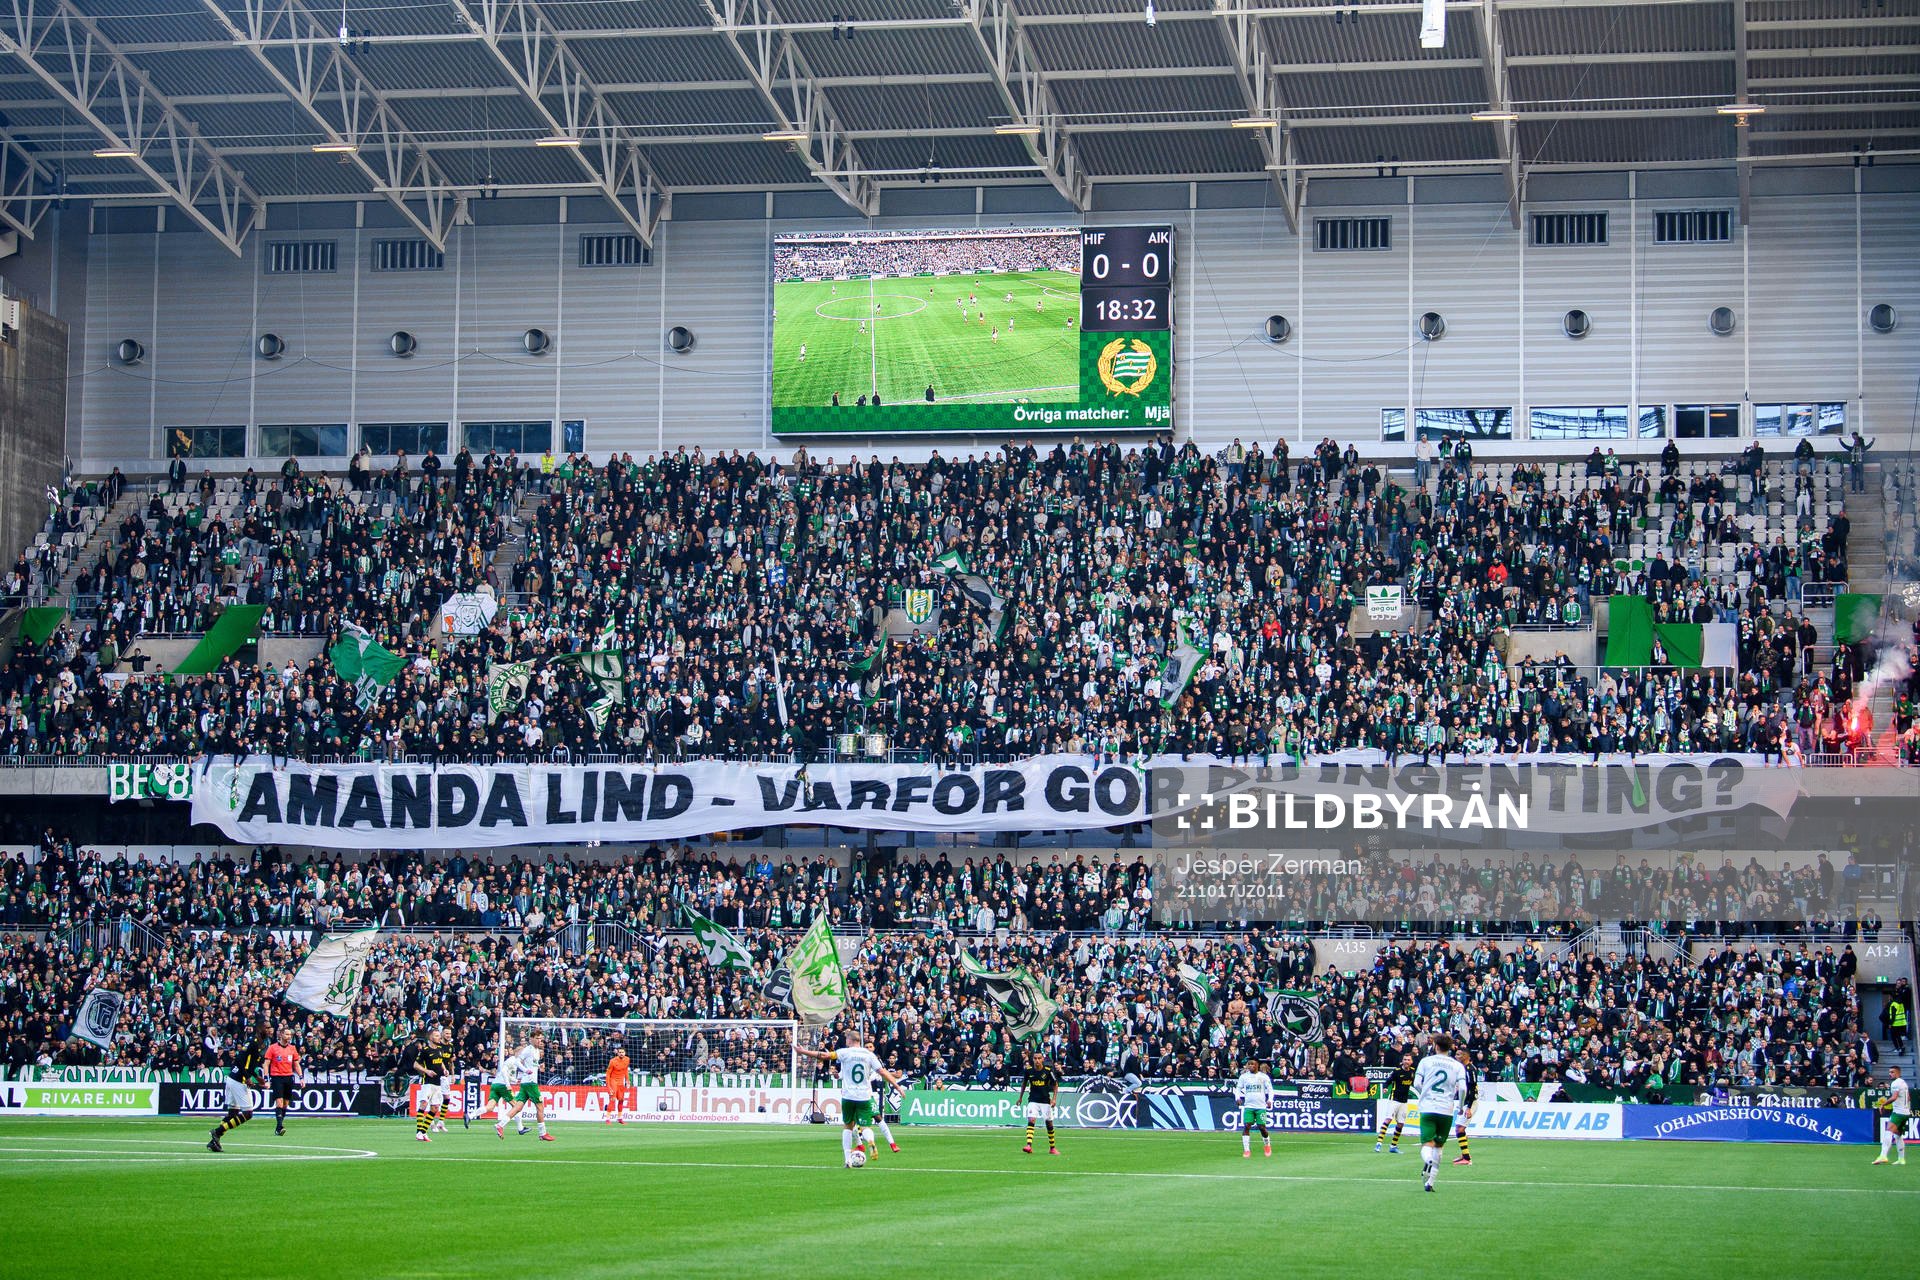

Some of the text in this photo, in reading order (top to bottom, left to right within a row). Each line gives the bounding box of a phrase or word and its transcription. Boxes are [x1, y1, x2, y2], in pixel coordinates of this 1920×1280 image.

[1084, 232, 1169, 245] HIF AIK
[1093, 254, 1109, 279] 0
[1142, 253, 1159, 278] 0
[1096, 300, 1157, 321] 18:32
[1014, 405, 1170, 422] Övriga matcher: Mjä
[237, 772, 528, 828] AMANDA
[546, 771, 693, 824] LIND
[711, 796, 735, 806] -
[757, 764, 1027, 815] VARFÖR
[1335, 942, 1366, 953] A135
[1865, 946, 1899, 957] A134
[851, 1064, 865, 1084] 6
[1432, 1070, 1448, 1093] 2
[41, 1092, 135, 1105] RIVARE.NU
[909, 1097, 1071, 1119] AudicomPeax
[635, 1112, 662, 1121] online
[679, 1112, 739, 1122] icabomben.se
[1221, 1106, 1373, 1130] glsmästeri
[1483, 1111, 1572, 1131] LINJEN
[1577, 1112, 1611, 1131] AB
[1653, 1108, 1843, 1141] JOHANNESHOVS RÖR AB
